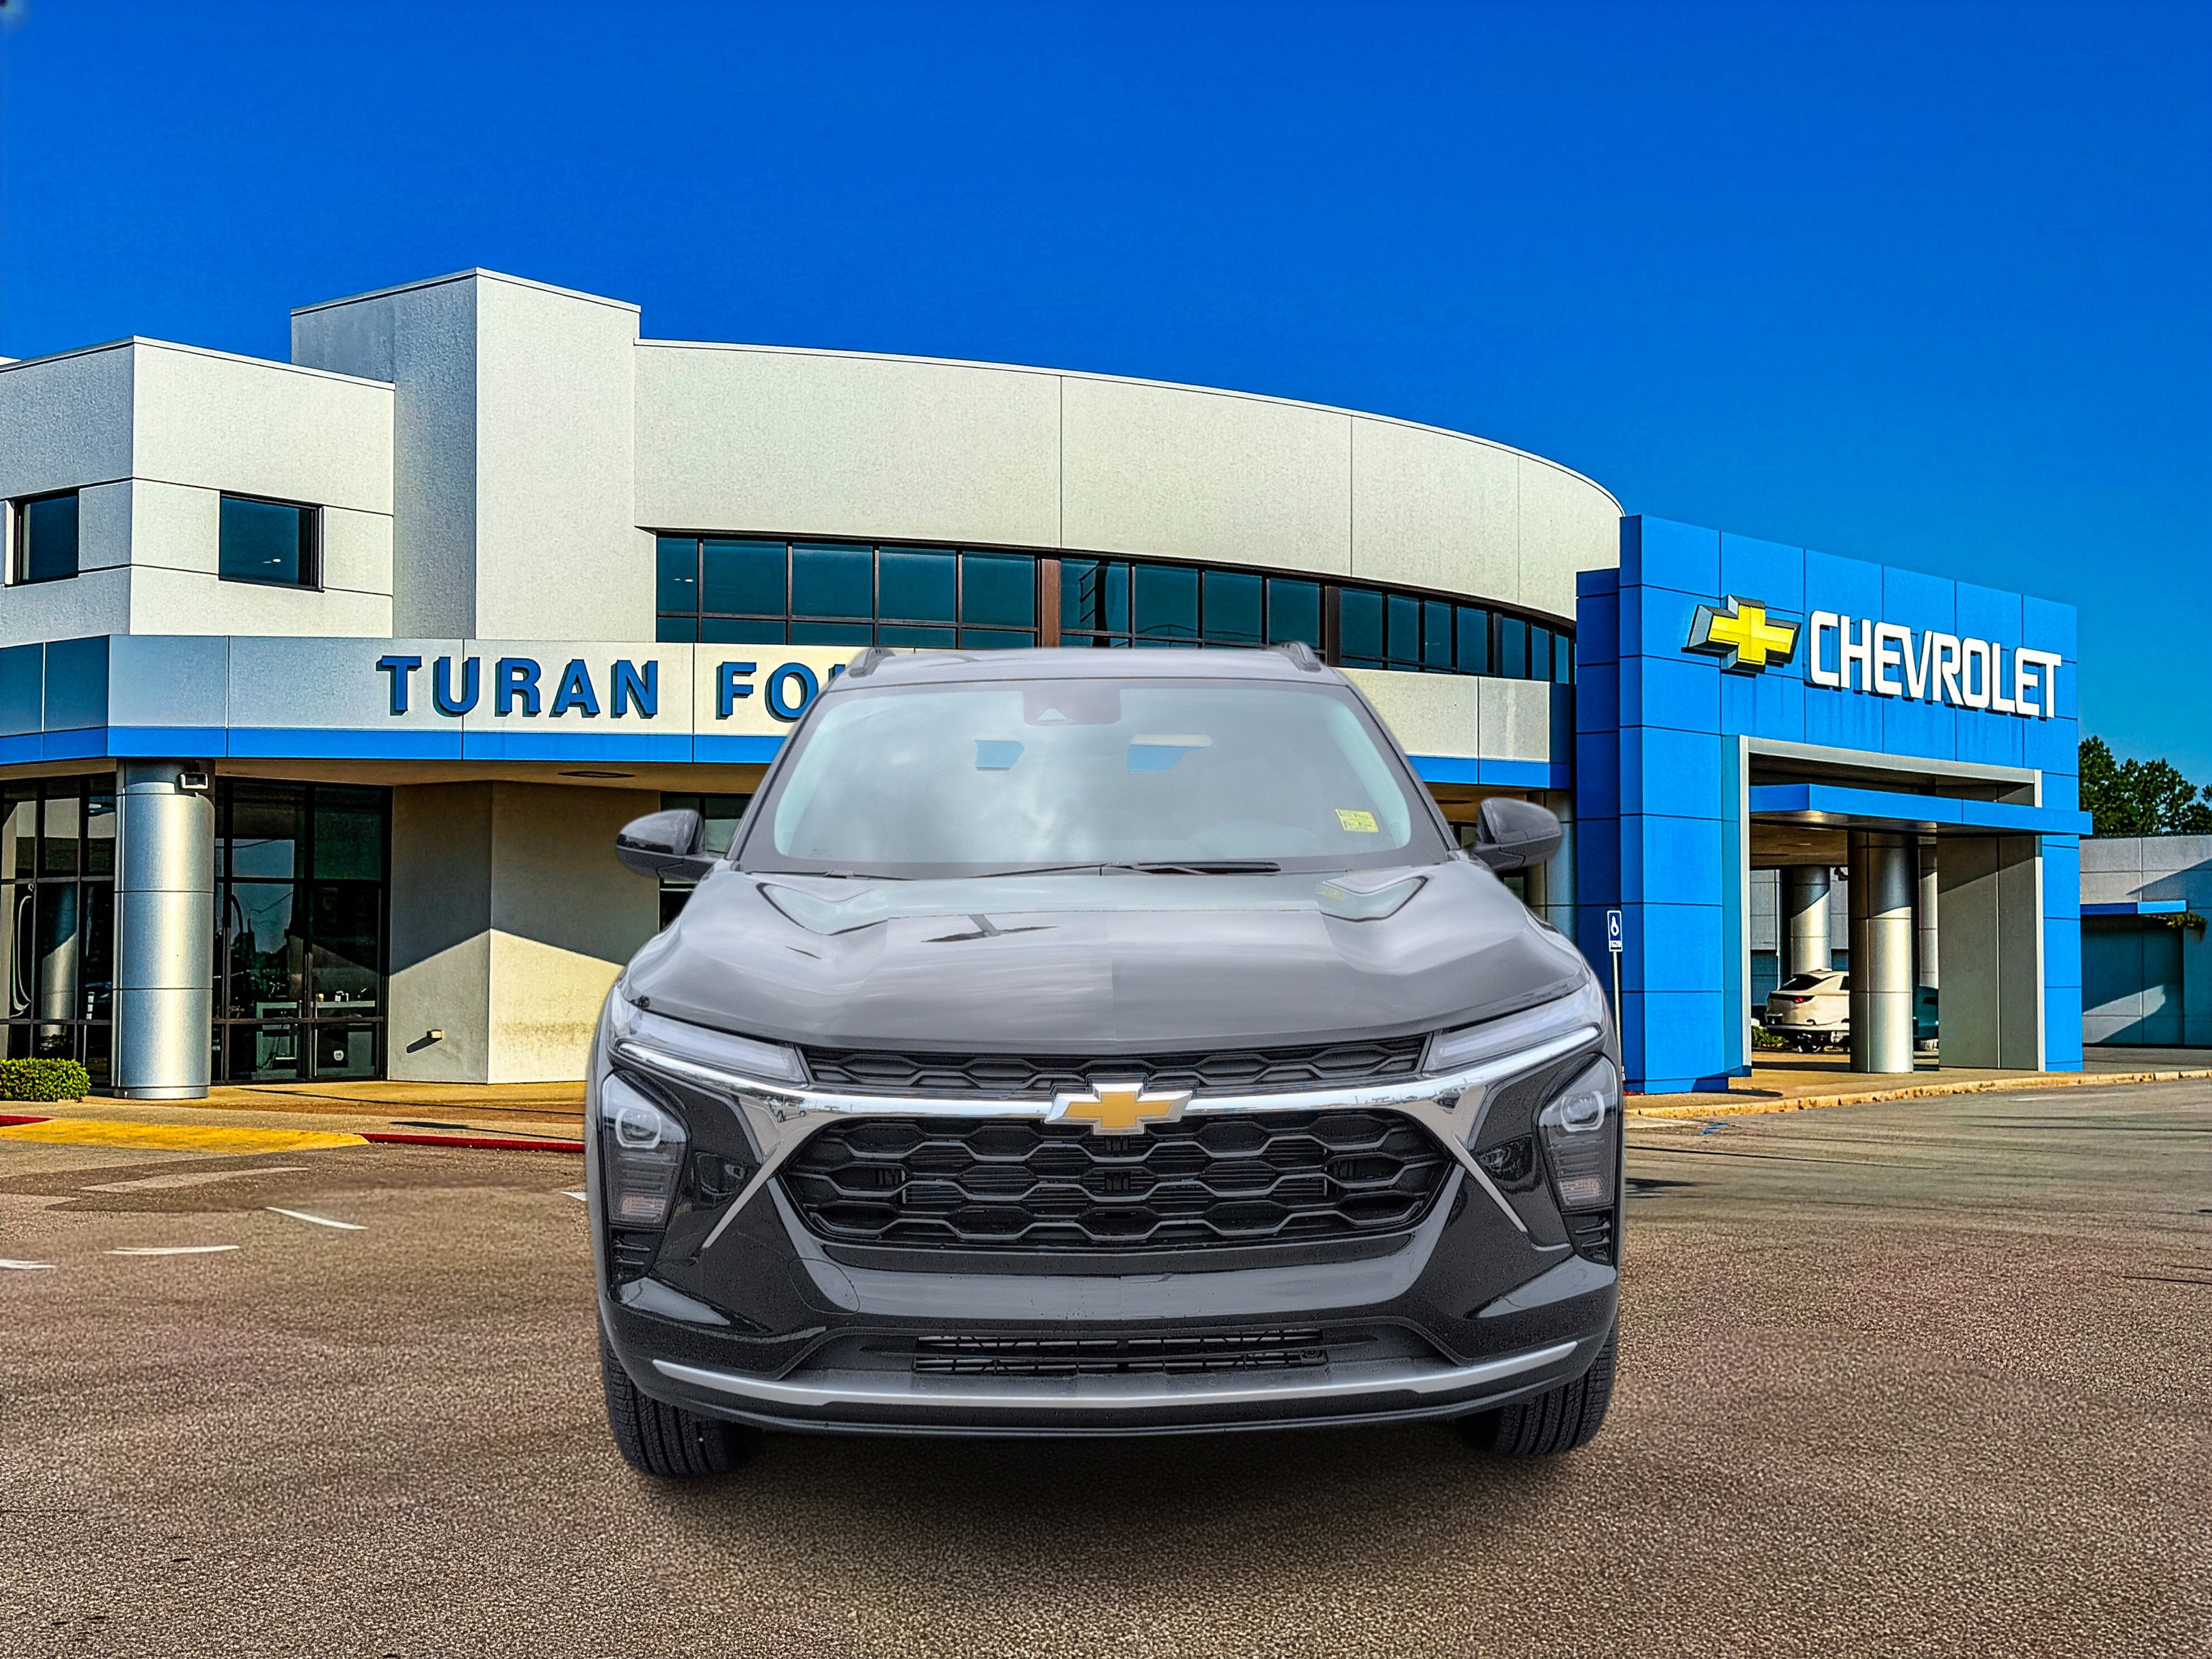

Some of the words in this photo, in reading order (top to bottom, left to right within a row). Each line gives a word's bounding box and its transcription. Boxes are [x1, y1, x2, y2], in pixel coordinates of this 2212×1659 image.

[376, 655, 658, 718] TURAN
[716, 661, 846, 723] FO
[1810, 610, 2061, 719] CHEVROLET
